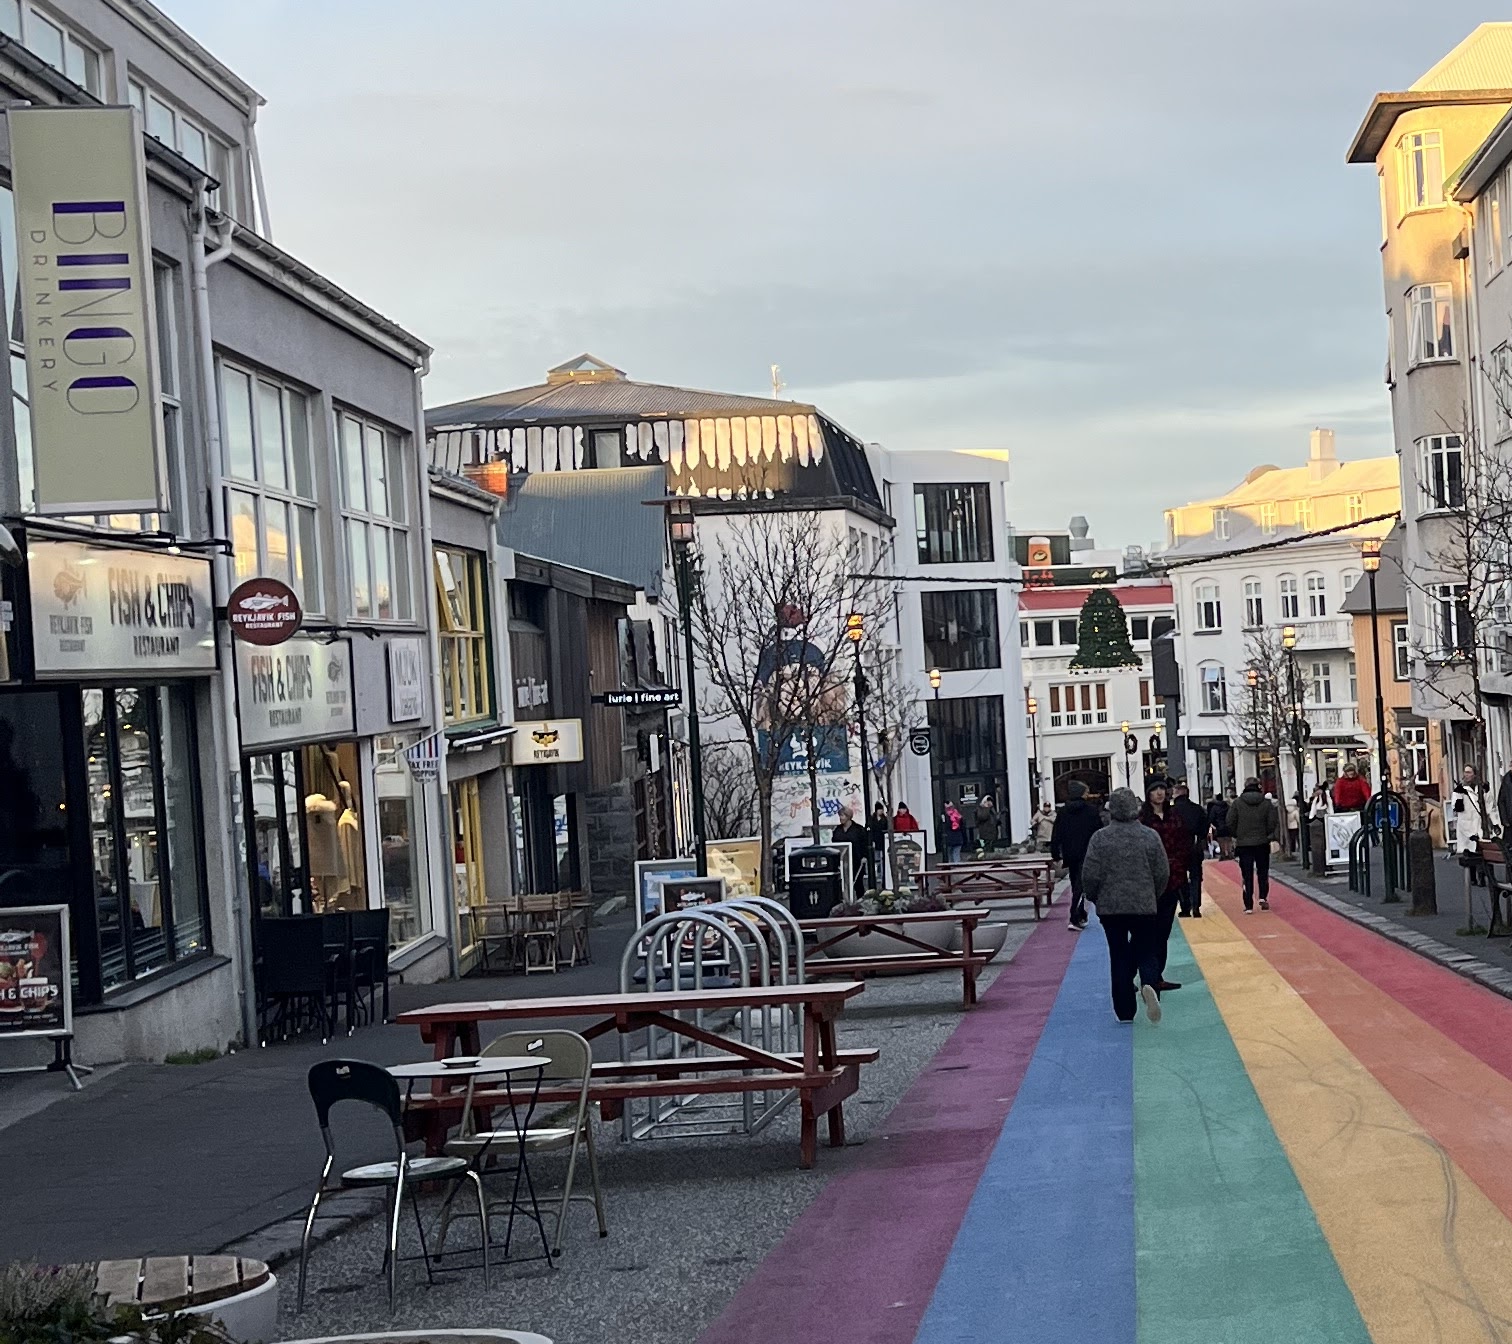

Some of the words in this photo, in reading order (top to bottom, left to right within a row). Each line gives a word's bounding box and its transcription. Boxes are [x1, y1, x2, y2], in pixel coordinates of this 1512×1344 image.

[30, 229, 59, 393] DRINKERY
[52, 201, 140, 415] BINGO
[108, 567, 141, 627] FISH
[144, 574, 158, 629] &
[157, 572, 195, 629] CHIPS
[232, 613, 275, 623] REYKJAVIK
[277, 612, 296, 621] FISH
[251, 655, 275, 704] FISH
[277, 657, 287, 703] &
[286, 654, 313, 702] CHIPS
[640, 692, 661, 703] fine
[663, 692, 679, 702] art
[20, 984, 59, 998] CHIPS
